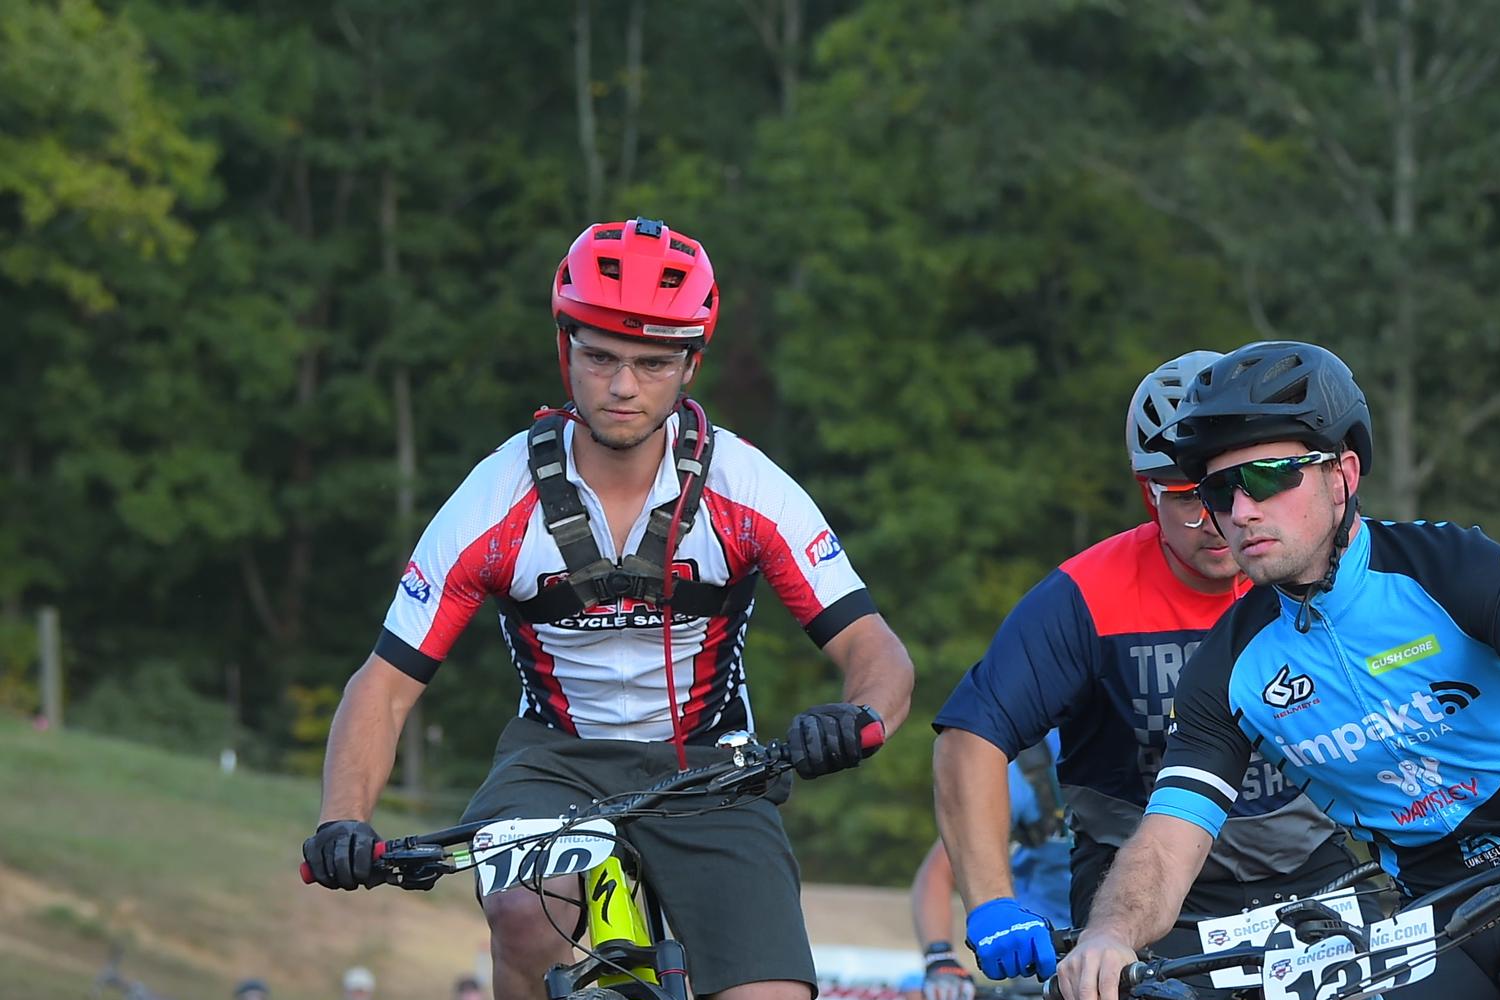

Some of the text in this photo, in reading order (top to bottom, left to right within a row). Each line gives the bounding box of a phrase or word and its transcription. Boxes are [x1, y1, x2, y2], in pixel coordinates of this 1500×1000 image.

[560, 616, 627, 628] CYCLE
[1371, 640, 1434, 670] CUSH CORE
[1275, 691, 1445, 767] impakt
[1389, 723, 1453, 750] MEDIA
[1391, 777, 1479, 826] WAMSLEY
